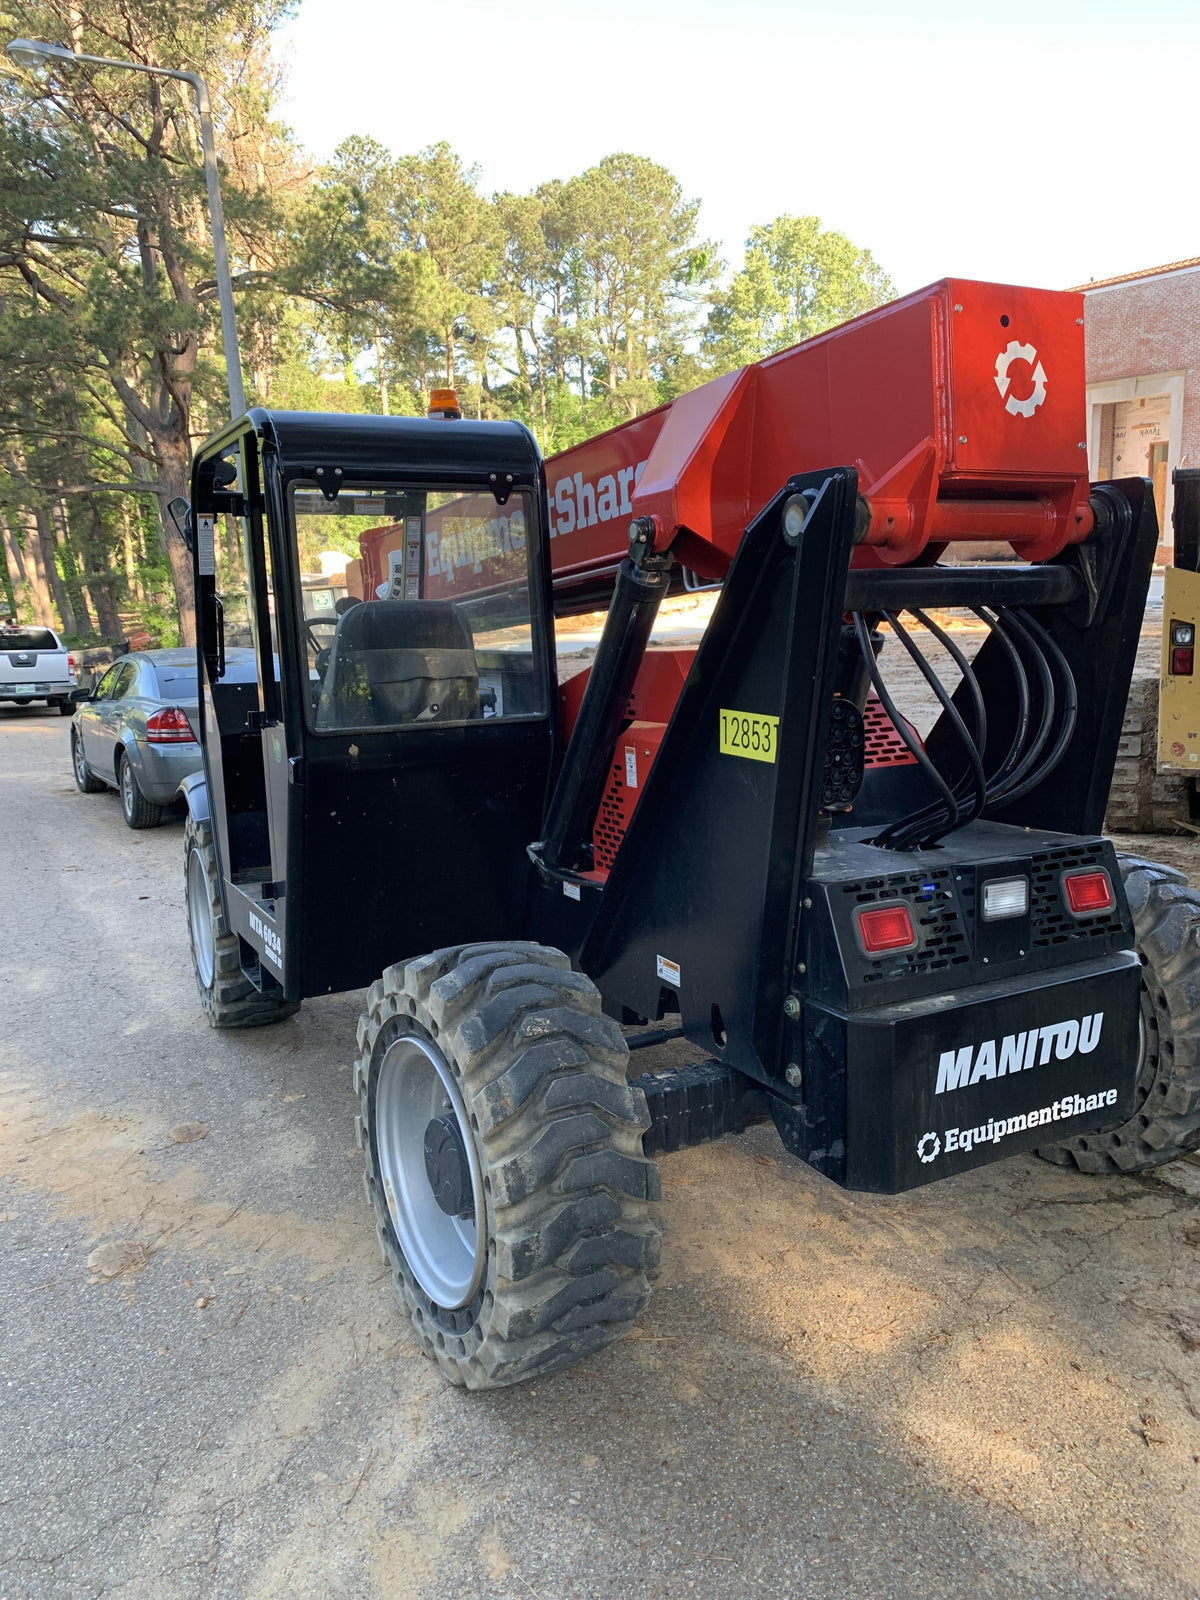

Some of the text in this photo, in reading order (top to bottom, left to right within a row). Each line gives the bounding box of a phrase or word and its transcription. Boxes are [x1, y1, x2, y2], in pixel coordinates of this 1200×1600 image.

[249, 911, 281, 955] MTA 6034
[934, 1012, 1104, 1095] MANITOU
[944, 1088, 1118, 1152] EquipmentShare
